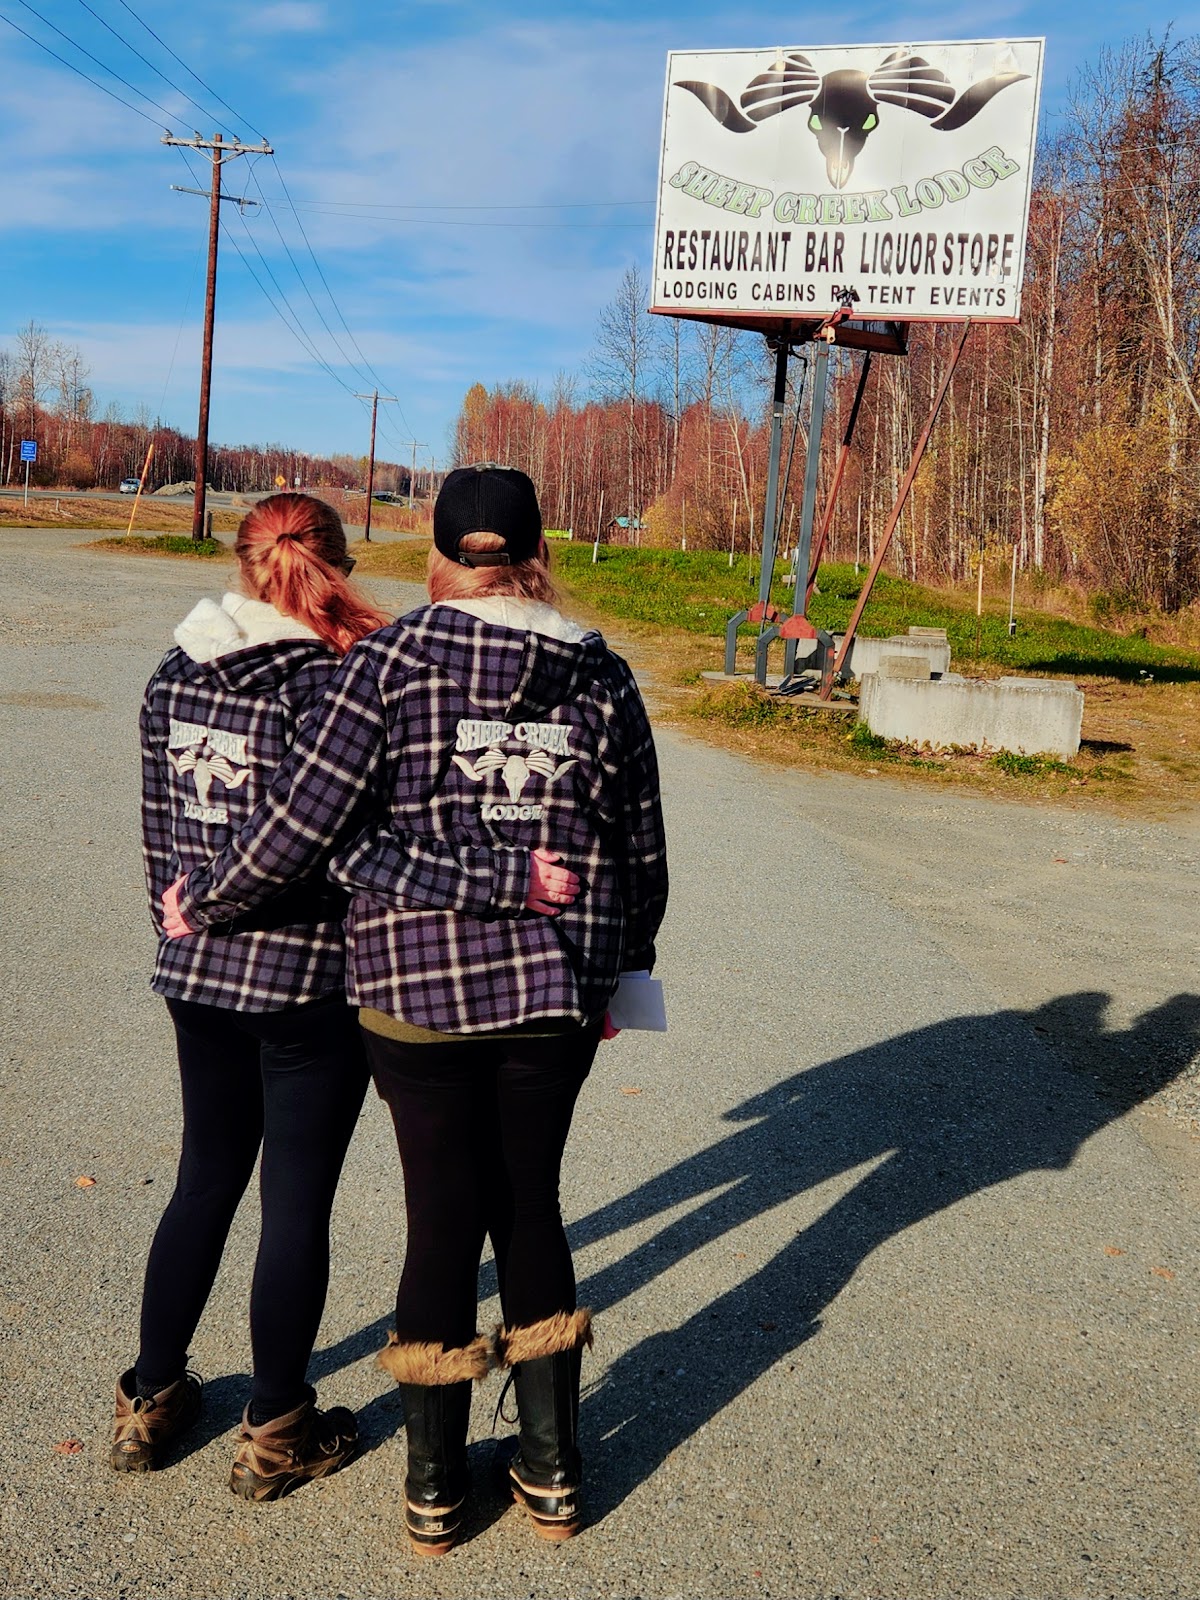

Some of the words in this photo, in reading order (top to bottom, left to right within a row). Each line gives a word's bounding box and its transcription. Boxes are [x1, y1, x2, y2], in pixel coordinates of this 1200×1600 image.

[669, 161, 774, 218] SHEEP
[773, 191, 893, 225] CREEK
[891, 146, 1020, 217] LODGE
[663, 230, 791, 272] RESTAURANT
[805, 231, 845, 273] BAR
[860, 232, 938, 278] LIQUOR
[942, 232, 1015, 277] STORE
[663, 281, 737, 299] LODGING
[752, 283, 816, 302] CABINS
[868, 285, 915, 304] TENT
[930, 286, 1006, 307] EVENTS
[455, 719, 514, 752] SHEEP
[514, 722, 574, 756] CREEK
[480, 804, 543, 821] LODGE
